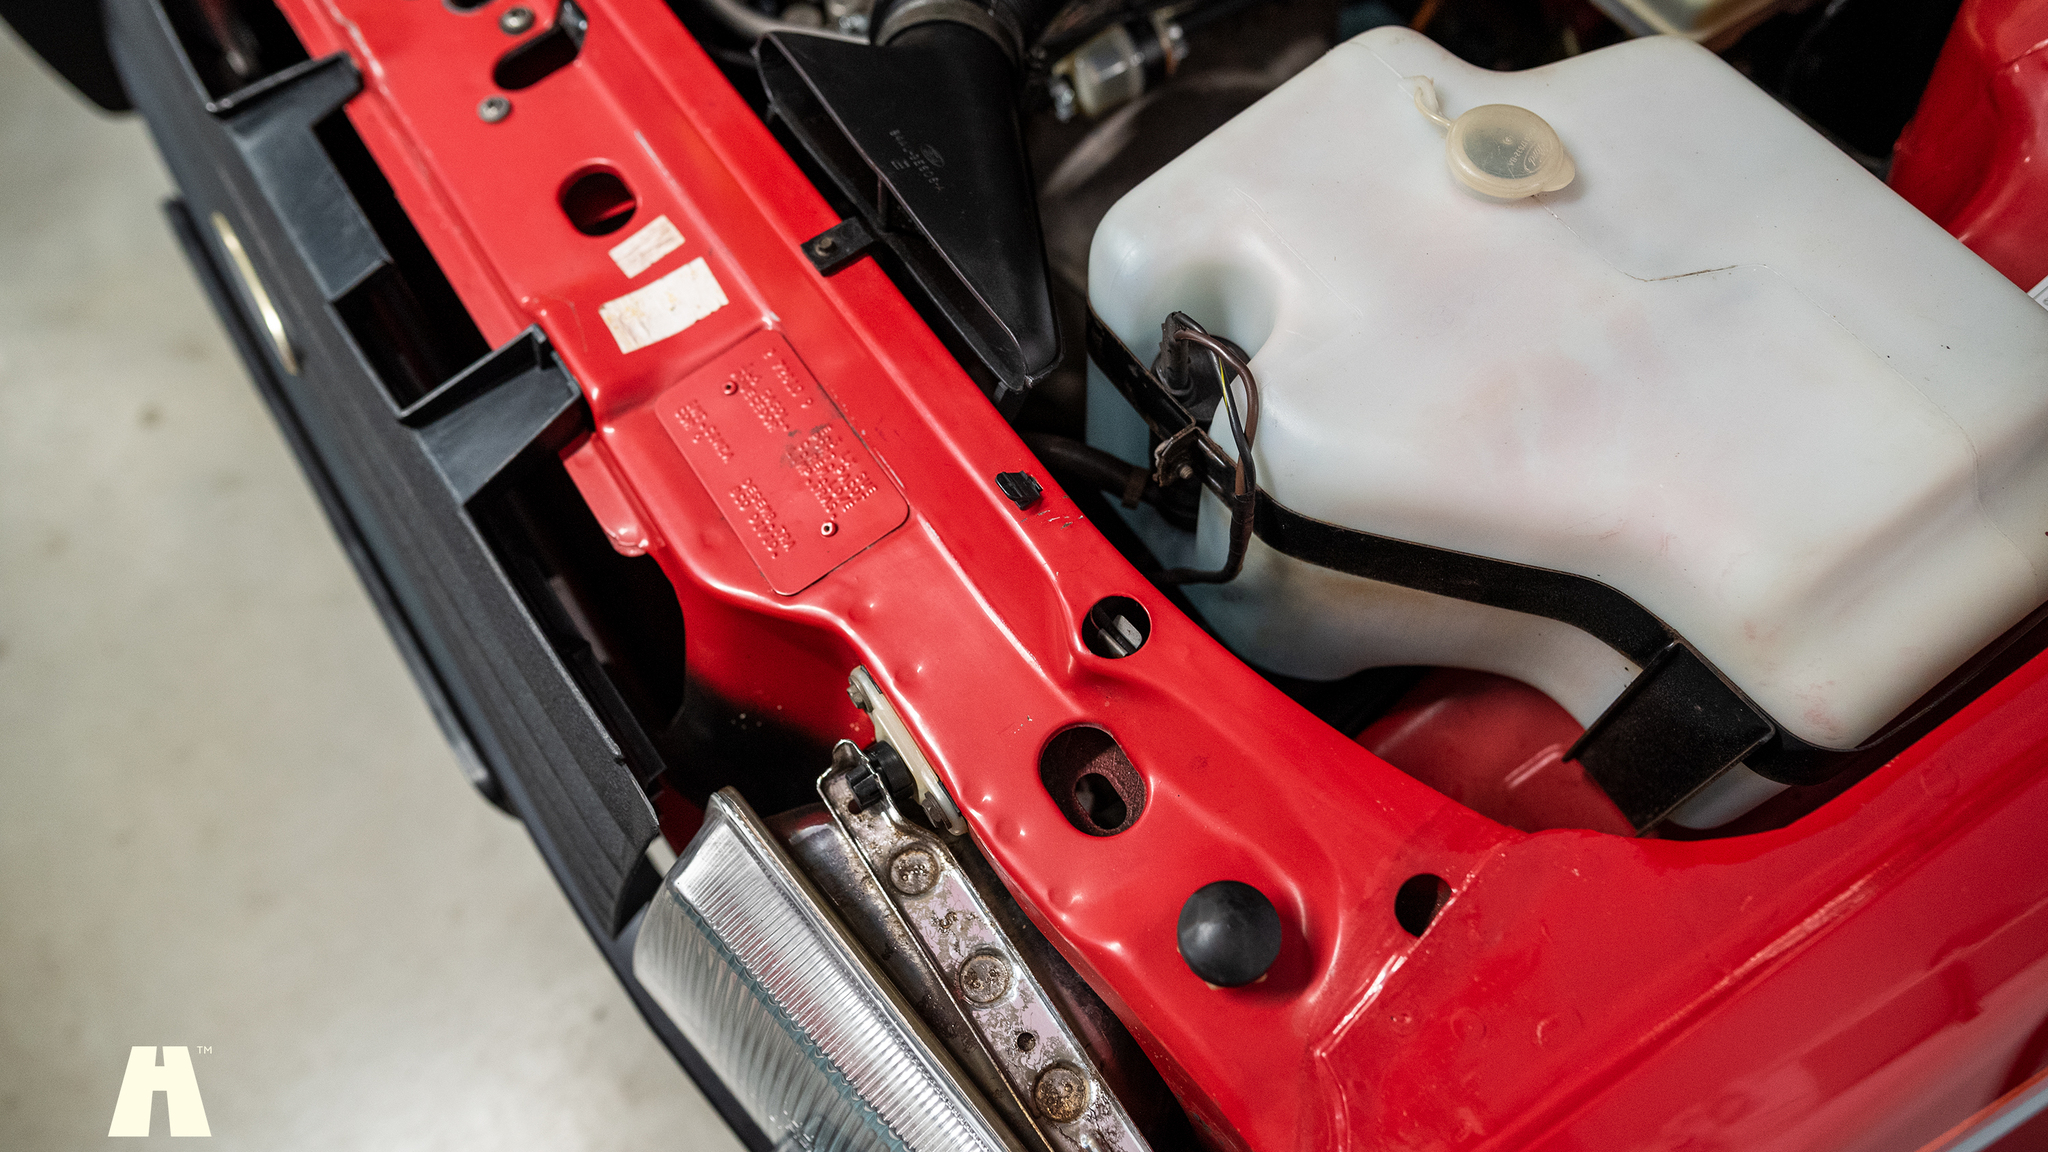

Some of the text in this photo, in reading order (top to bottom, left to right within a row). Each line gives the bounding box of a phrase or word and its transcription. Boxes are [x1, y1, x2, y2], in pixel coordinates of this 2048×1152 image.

[851, 469, 879, 498] SUE
[738, 475, 799, 553] DESEMB.TRA
[744, 512, 786, 561] DIVID.
